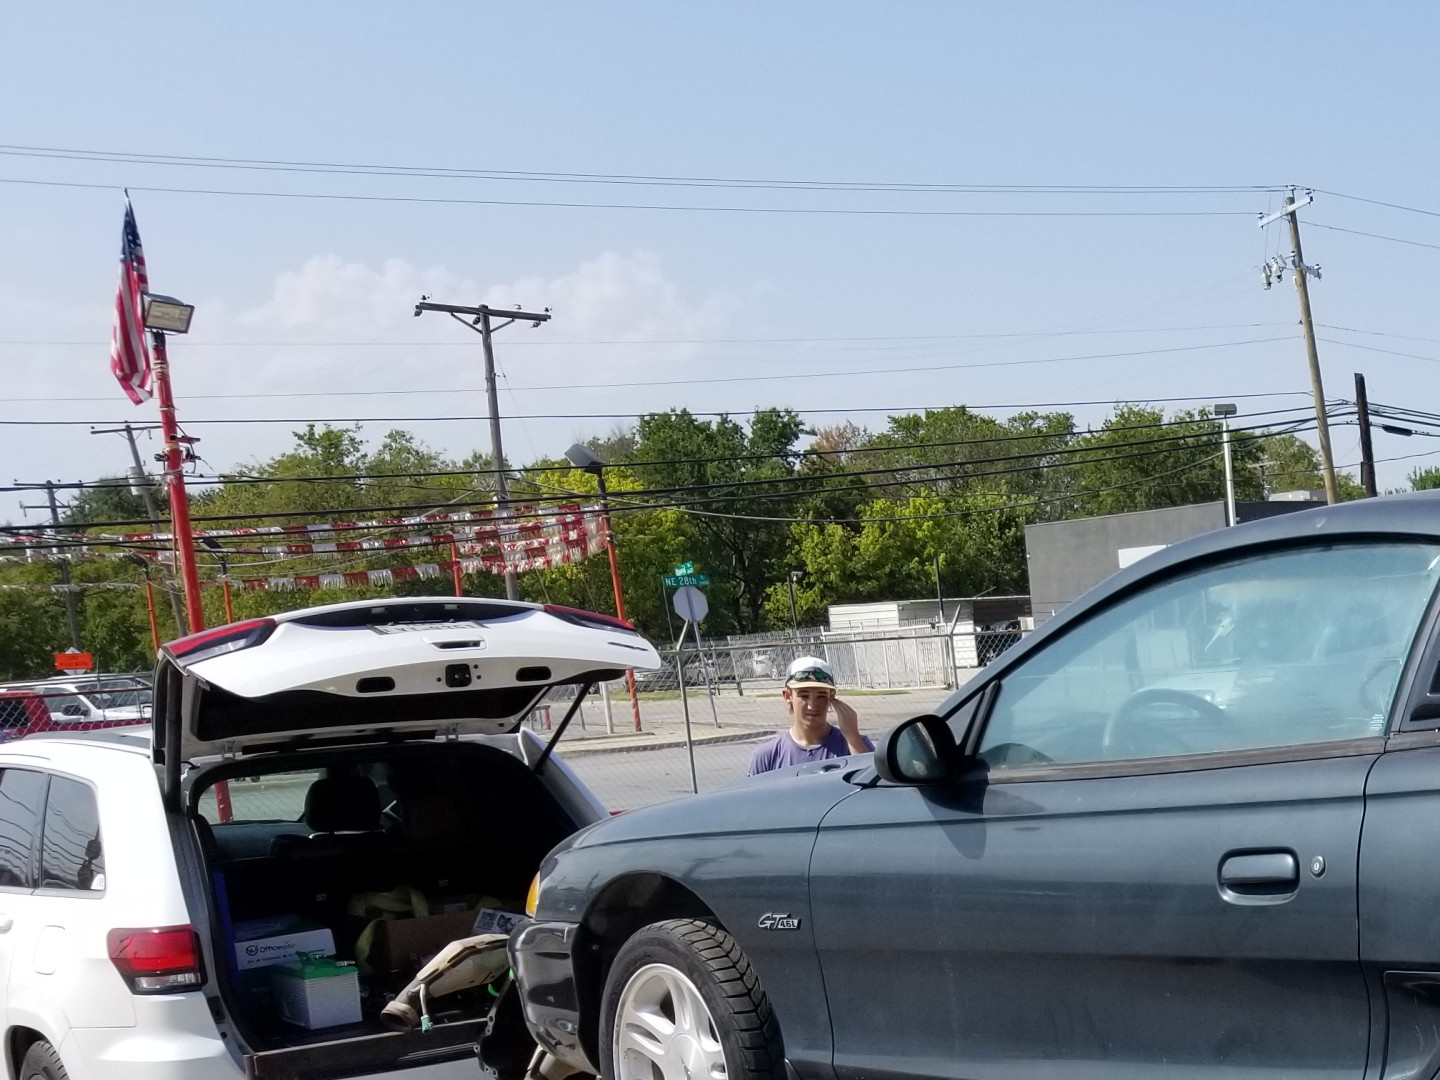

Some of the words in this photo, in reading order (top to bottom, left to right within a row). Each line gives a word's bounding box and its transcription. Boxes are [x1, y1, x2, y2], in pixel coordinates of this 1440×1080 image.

[664, 577, 677, 586] NE
[678, 576, 697, 586] 28th
[758, 913, 788, 929] GT
